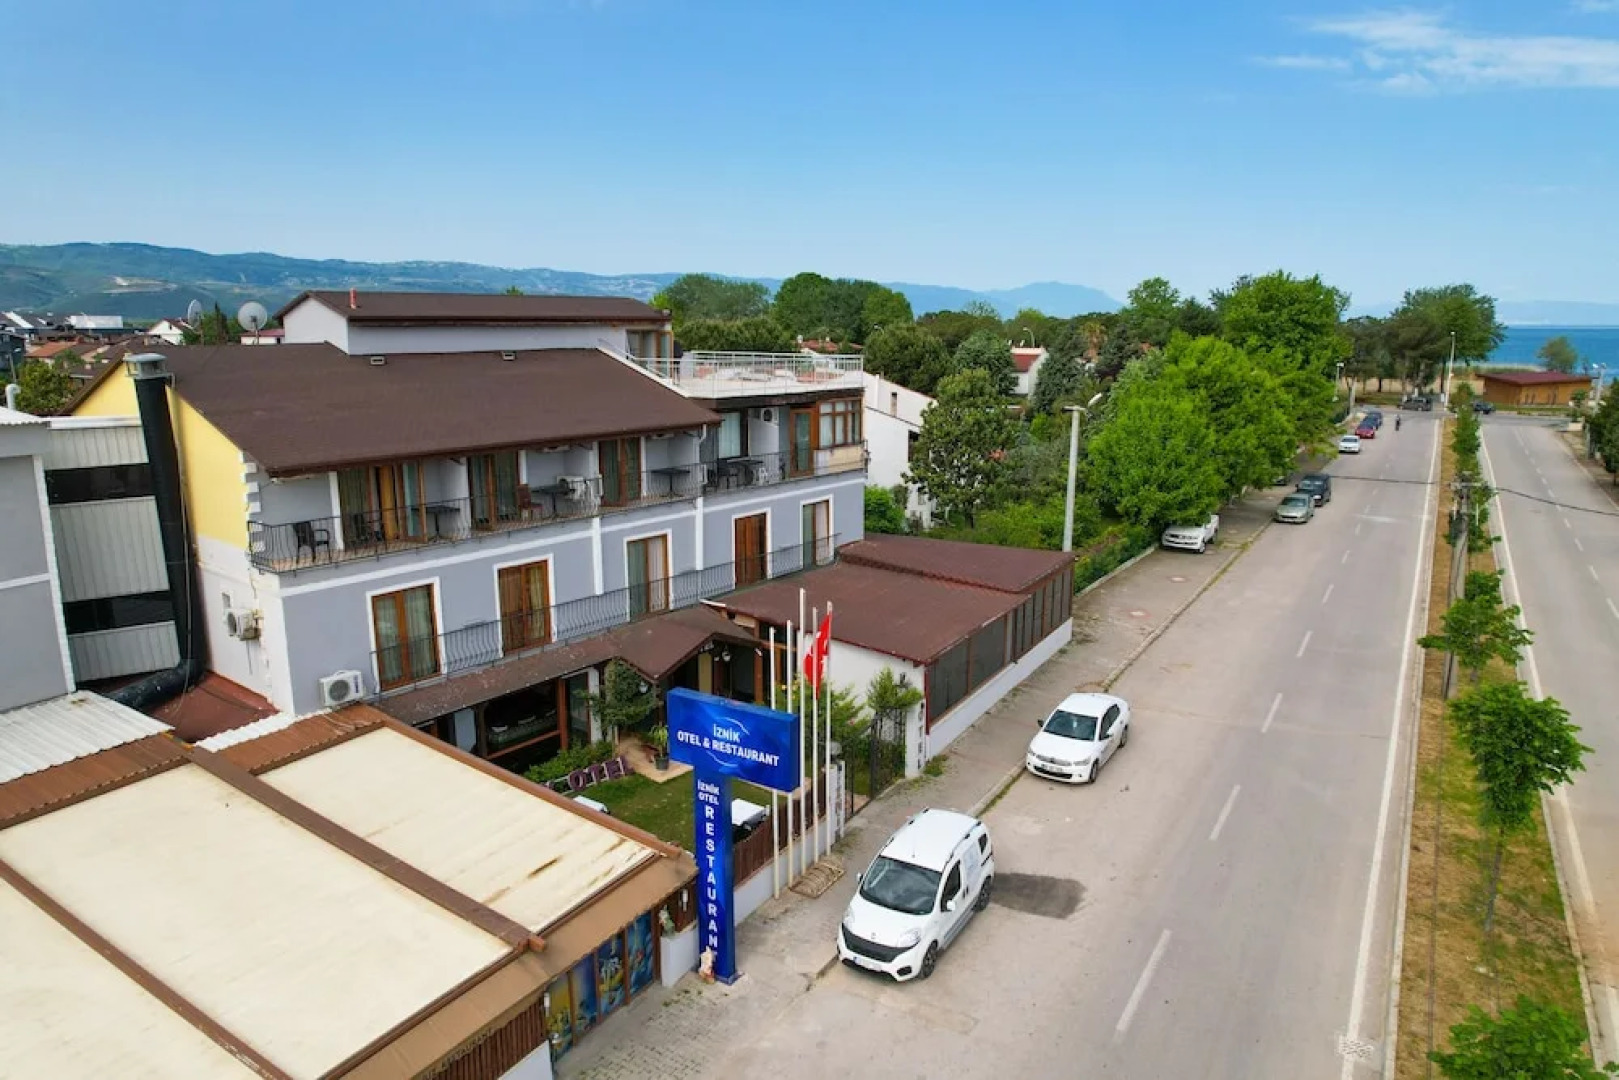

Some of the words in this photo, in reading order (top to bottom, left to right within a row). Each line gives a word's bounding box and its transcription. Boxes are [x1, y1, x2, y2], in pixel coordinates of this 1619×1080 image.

[677, 730, 701, 747] OTEL
[703, 737, 710, 749] &
[712, 740, 779, 767] RESTAURANT
[698, 791, 720, 806] OTEL
